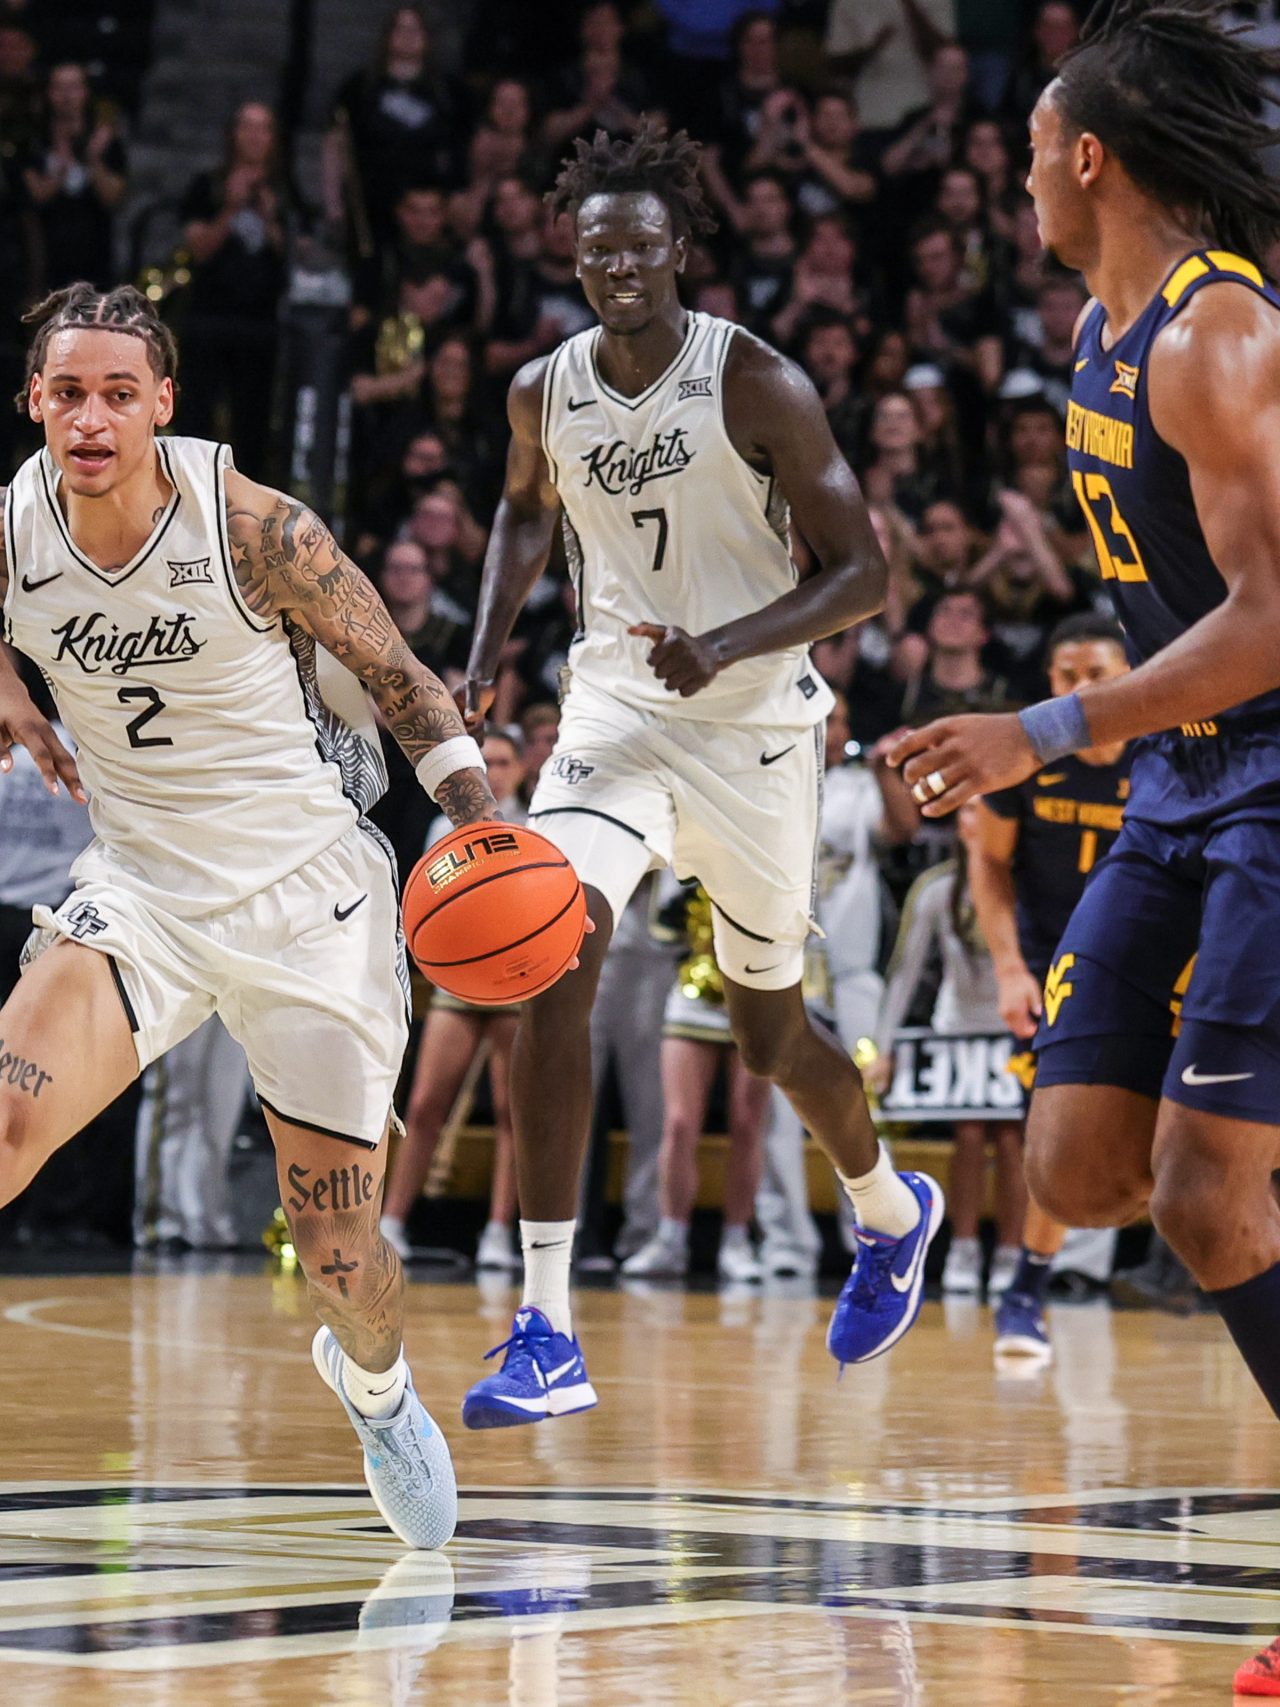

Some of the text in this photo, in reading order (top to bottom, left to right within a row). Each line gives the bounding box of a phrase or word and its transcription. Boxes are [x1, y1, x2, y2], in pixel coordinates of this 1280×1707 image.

[581, 428, 697, 496] Knights
[631, 507, 669, 572] 7
[1072, 470, 1150, 583] 13
[166, 556, 215, 588] XII
[51, 612, 208, 675] Knights
[117, 686, 175, 748] 2
[425, 833, 519, 888] ELITE
[288, 1162, 373, 1213] Settle
